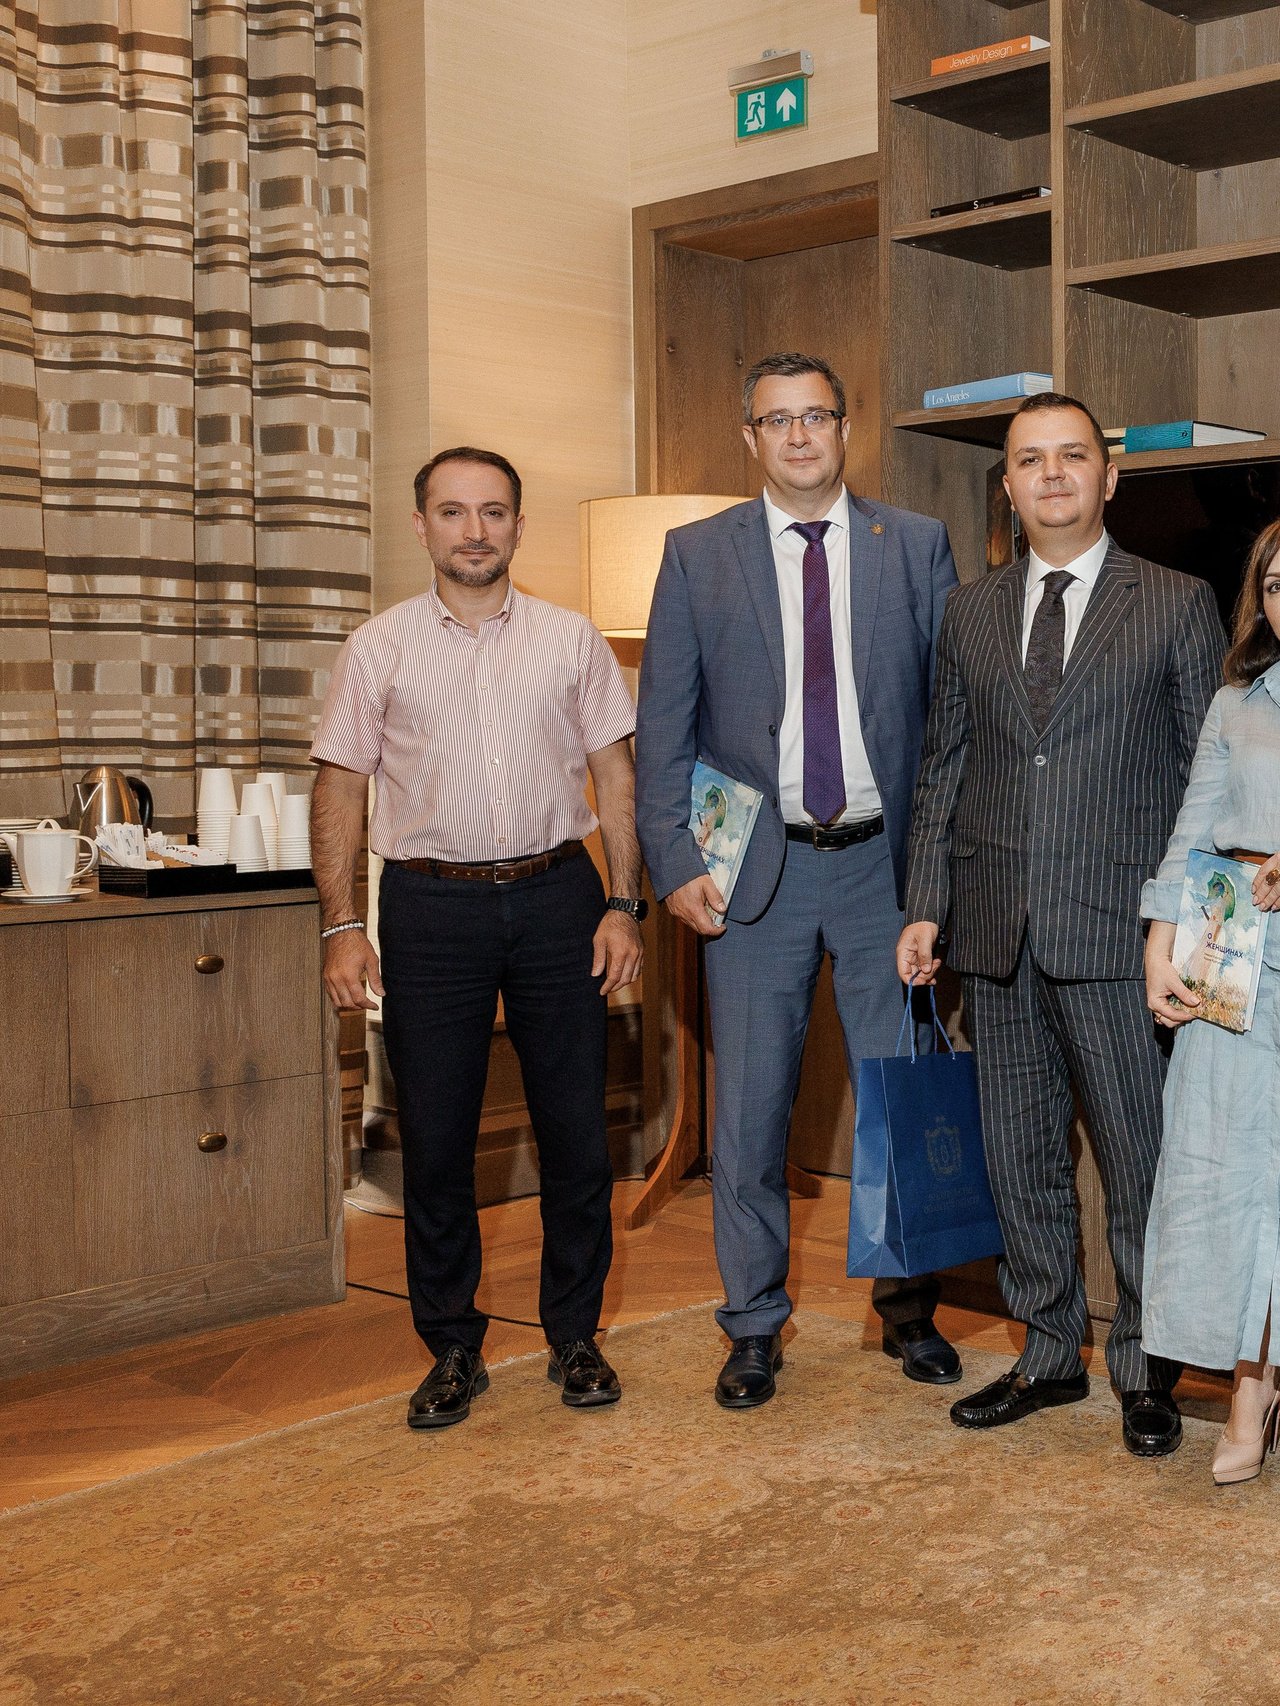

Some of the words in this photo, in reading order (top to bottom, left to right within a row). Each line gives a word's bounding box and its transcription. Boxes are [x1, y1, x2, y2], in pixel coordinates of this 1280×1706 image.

[949, 53, 982, 69] Jewelry
[982, 45, 1013, 60] Design
[931, 394, 945, 406] Los
[945, 389, 970, 403] Angeles
[1205, 941, 1244, 958] ЖЕНЩИНАХ
